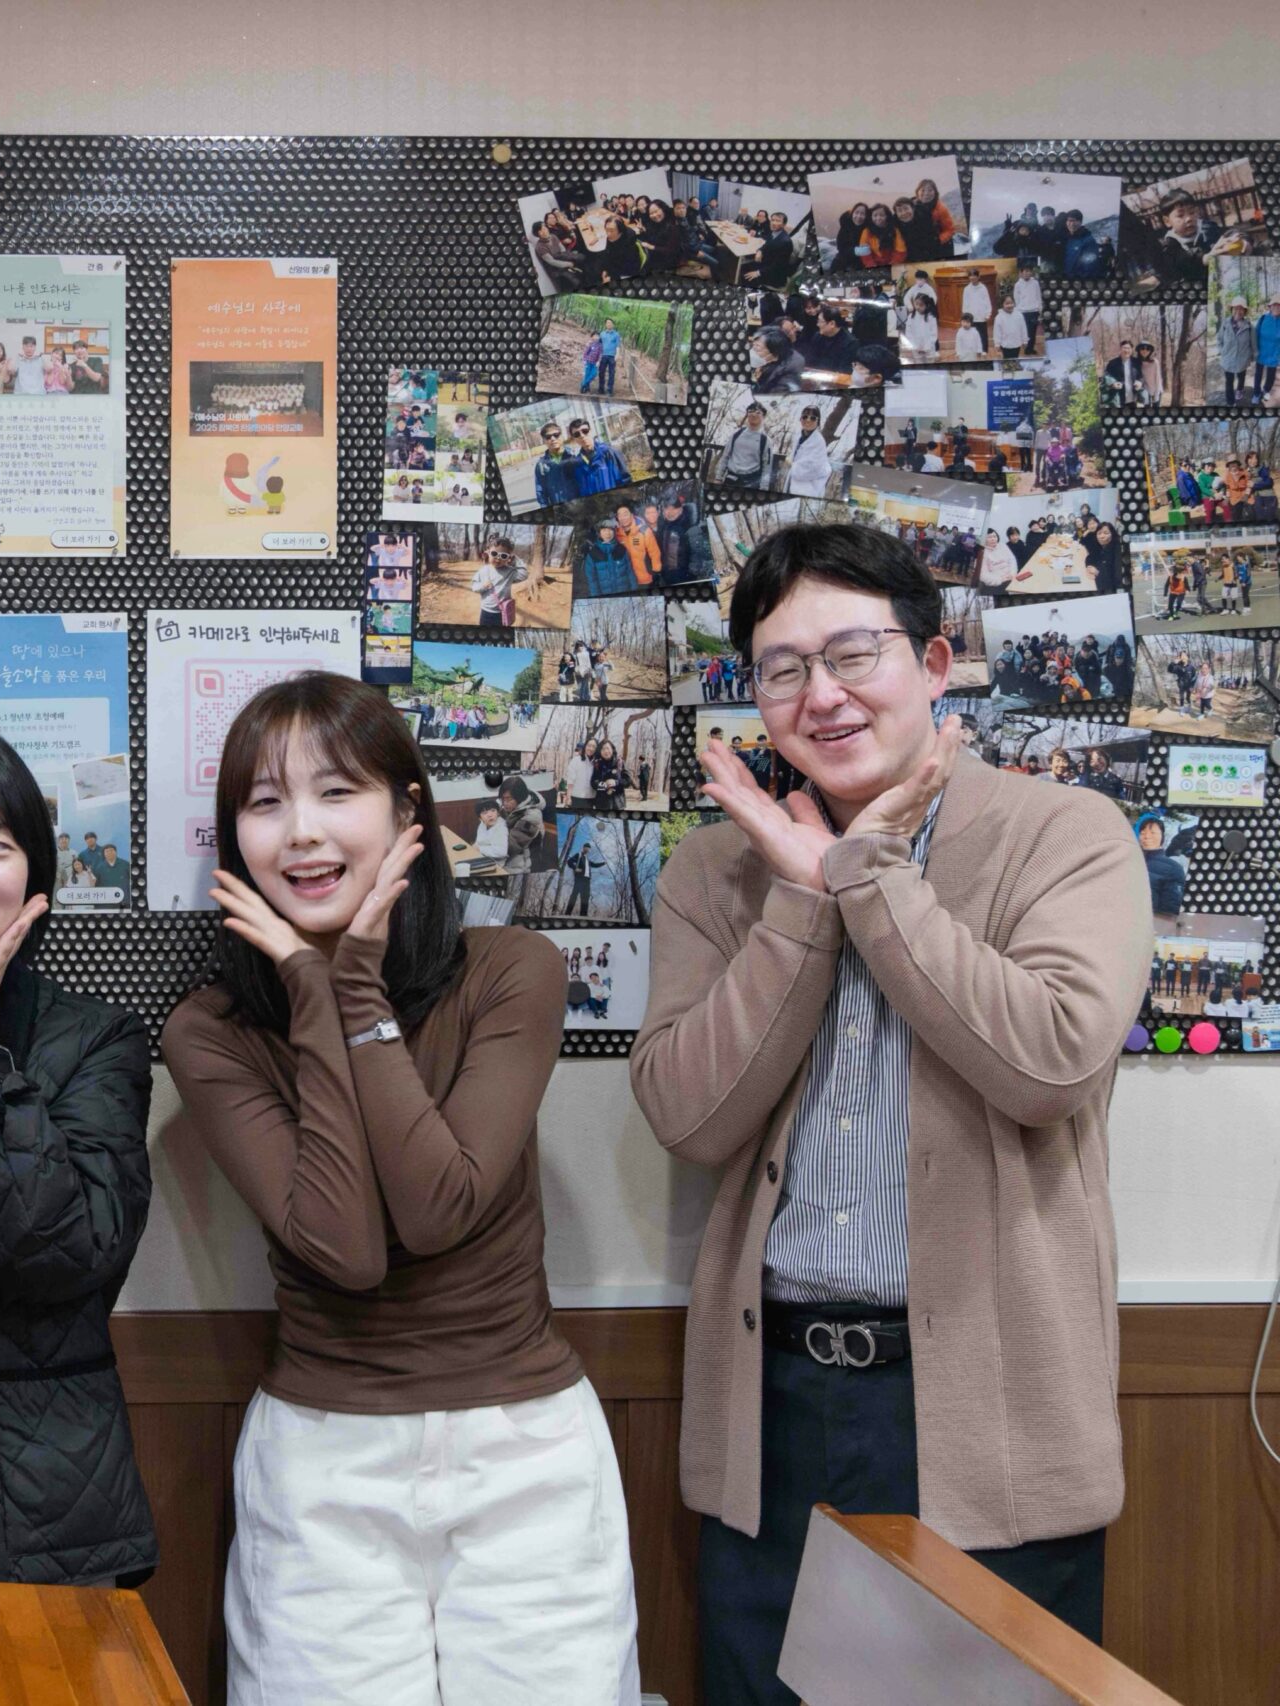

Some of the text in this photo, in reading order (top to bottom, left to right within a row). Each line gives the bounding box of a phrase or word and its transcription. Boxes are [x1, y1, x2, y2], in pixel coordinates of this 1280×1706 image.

[288, 265, 310, 274] 신앙의
[3, 282, 81, 295] 나를 인도하시는
[14, 300, 71, 312] 나의 하나님
[207, 300, 301, 315] 예수님의 사랑에
[195, 423, 218, 432] 2025
[61, 535, 102, 544] 더 보러 가기
[272, 536, 313, 546] 더 보러 가기
[83, 620, 112, 629] 교회 행사
[187, 625, 341, 645] 카메라로 인식해주세요
[11, 644, 87, 661] 땅에 있으나
[56, 669, 80, 683] 품은
[83, 668, 107, 683] 우리
[10, 712, 32, 721] 청년부
[66, 891, 106, 901] 더 보러 가기
